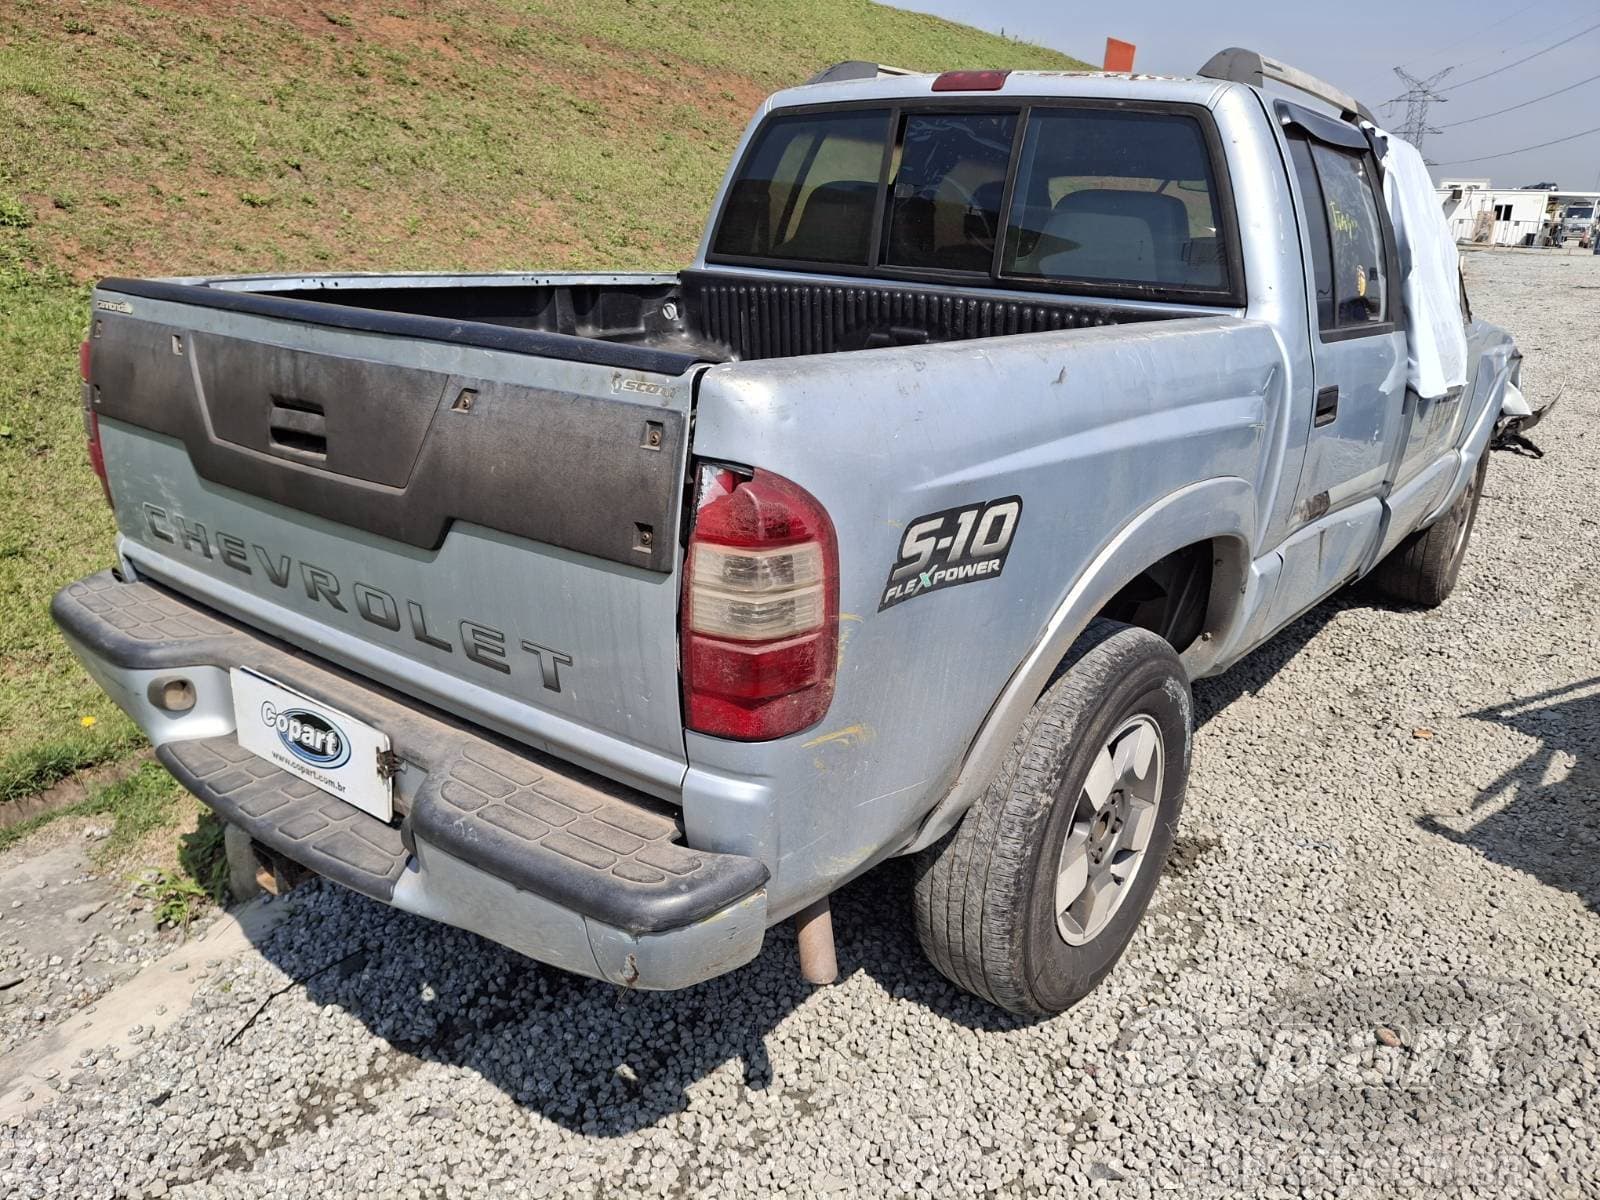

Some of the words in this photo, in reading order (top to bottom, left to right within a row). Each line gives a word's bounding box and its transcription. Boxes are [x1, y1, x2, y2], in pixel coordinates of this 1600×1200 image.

[891, 501, 1019, 581] S-10
[142, 502, 573, 693] CHEVROLET
[260, 700, 338, 756] Copart
[271, 750, 347, 793] www.copart.com.br
